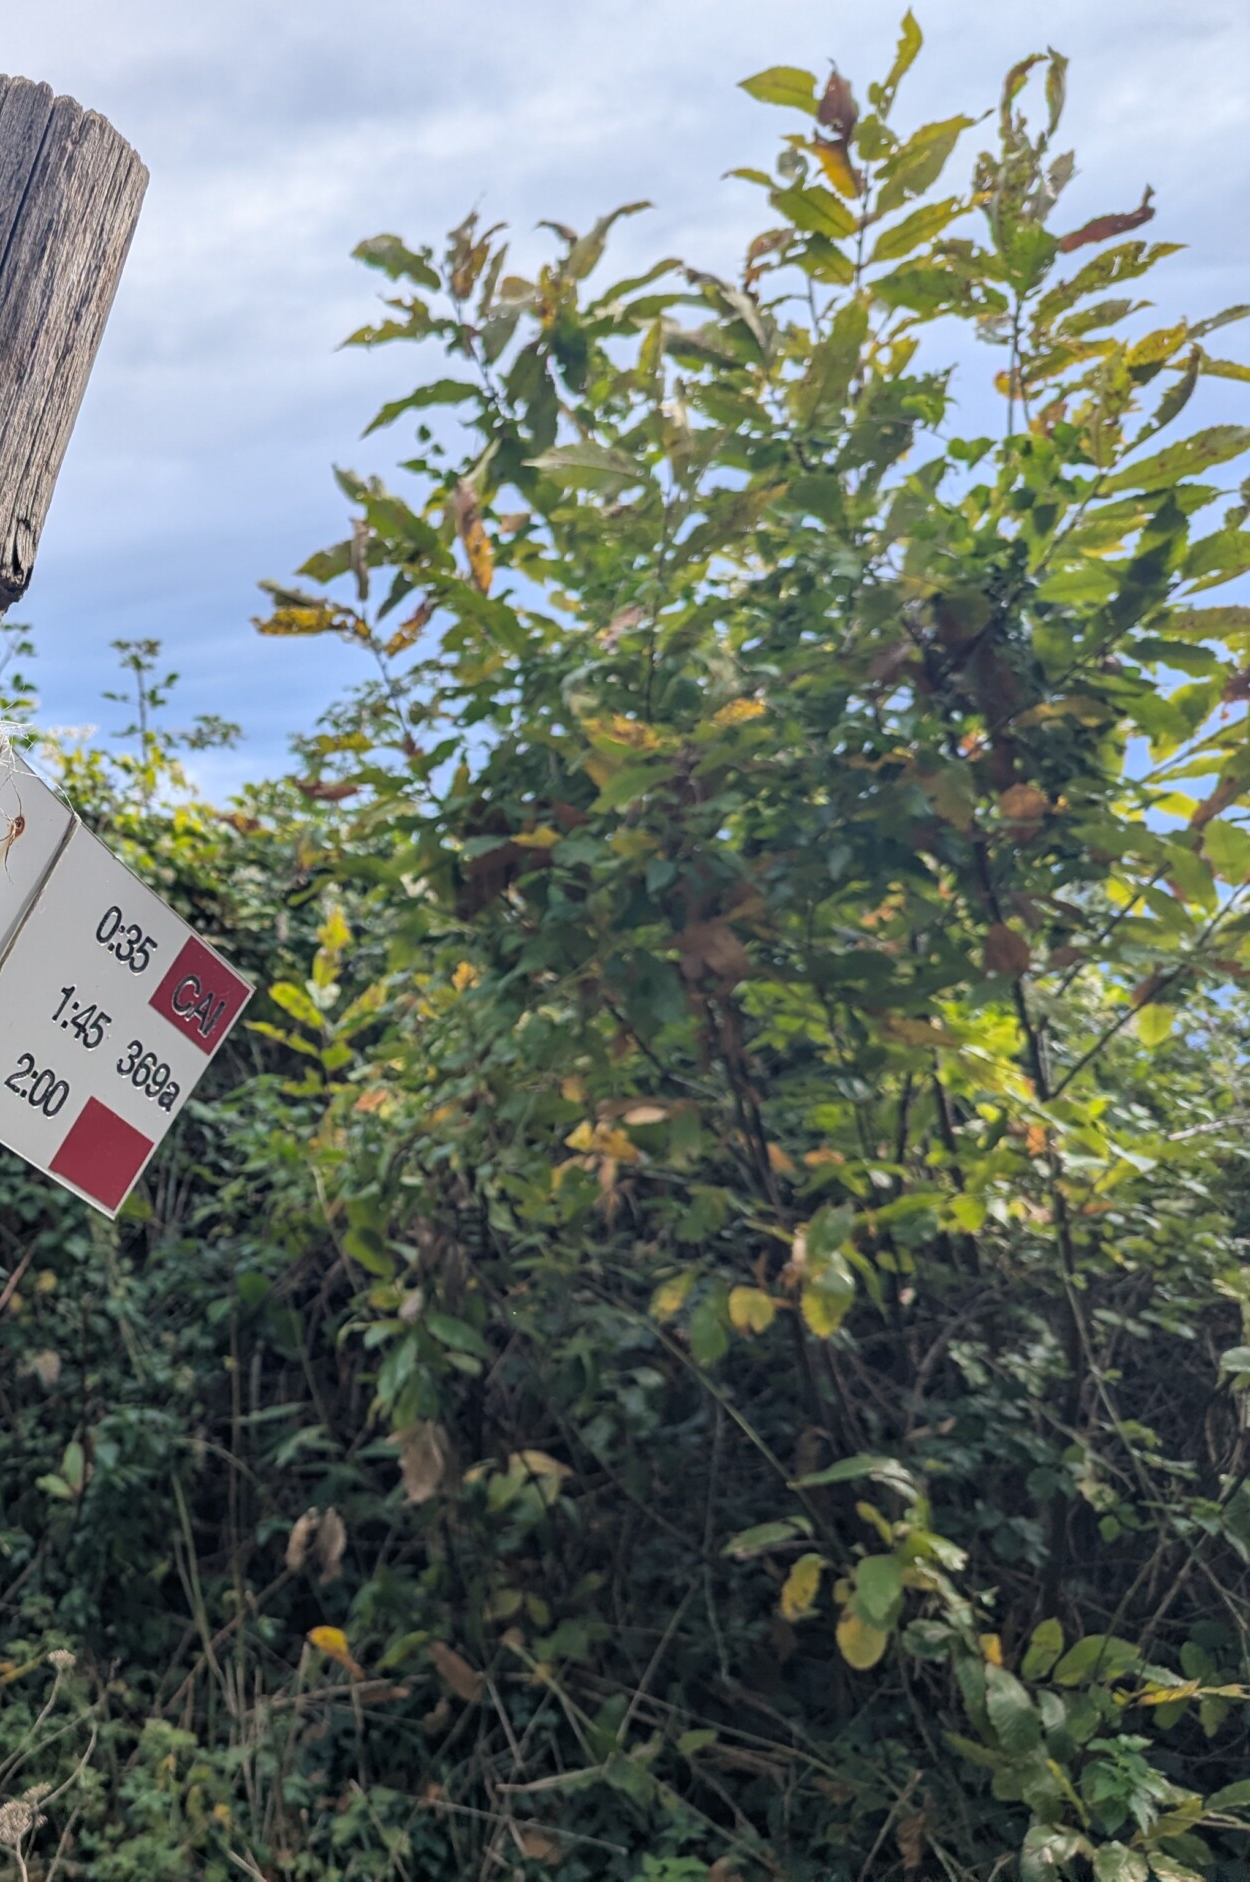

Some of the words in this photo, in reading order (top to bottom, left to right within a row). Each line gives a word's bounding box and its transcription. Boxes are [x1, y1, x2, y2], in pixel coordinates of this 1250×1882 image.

[95, 906, 158, 975] 0:35
[51, 985, 113, 1051] 1:45
[171, 975, 227, 1037] CAI
[4, 1053, 71, 1119] 2:00
[116, 1040, 181, 1113] 369a
